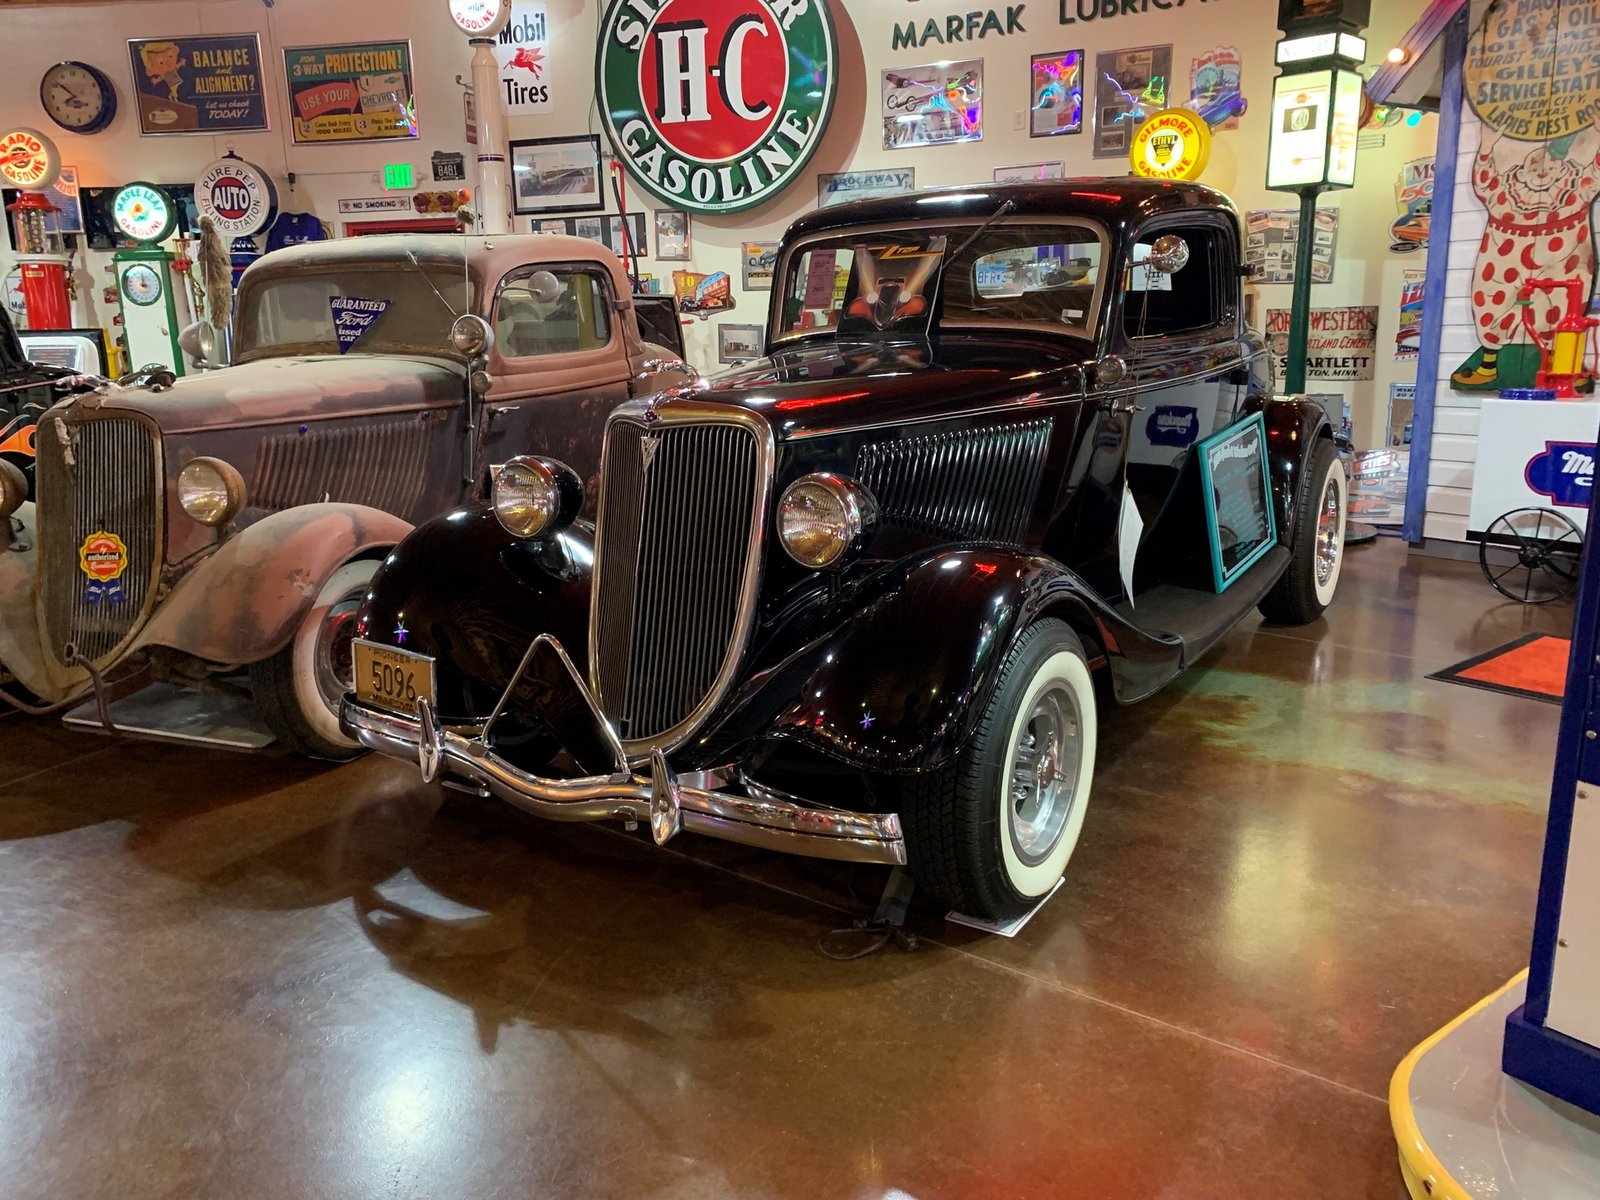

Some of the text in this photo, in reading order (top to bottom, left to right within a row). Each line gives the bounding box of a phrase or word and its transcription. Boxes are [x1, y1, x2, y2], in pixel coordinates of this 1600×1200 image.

[456, 10, 494, 29] GASOLINE
[500, 13, 545, 45] Mobil
[892, 4, 1026, 50] MARFAK
[192, 48, 250, 68] BALANCE
[324, 50, 402, 74] PROTECTION!
[195, 74, 255, 94] ALIGNMENT?
[503, 79, 548, 105] Tires
[1476, 82, 1547, 105] SERVICE
[205, 101, 217, 109] Let
[228, 99, 250, 108] check
[302, 89, 350, 111] USE YOUR
[1508, 100, 1548, 114] QUEEN
[208, 109, 249, 119] TODAY!
[1530, 107, 1568, 119] TEXAS
[1140, 117, 1193, 143] GILMORE
[1536, 114, 1570, 136] REST
[0, 134, 41, 153] RADIO
[1152, 135, 1176, 145] ETHYL
[621, 109, 814, 202] GASOLINE
[4, 159, 46, 181] GASOLINE
[203, 166, 256, 190] PURE PEP
[827, 173, 909, 192] BROCKWAY
[117, 188, 164, 212] MAPLE LEAF
[213, 186, 250, 210] AUTO
[365, 200, 397, 208] SMOKING
[233, 200, 261, 231] STATION
[331, 299, 386, 311] GUARANTEED
[335, 311, 374, 326] Ford
[1269, 310, 1377, 332] NORWESTERN
[338, 328, 362, 336] used
[340, 334, 355, 342] car
[1307, 357, 1370, 368] ARTLETT
[374, 649, 411, 664] PIONEER
[372, 660, 416, 702] 5096
